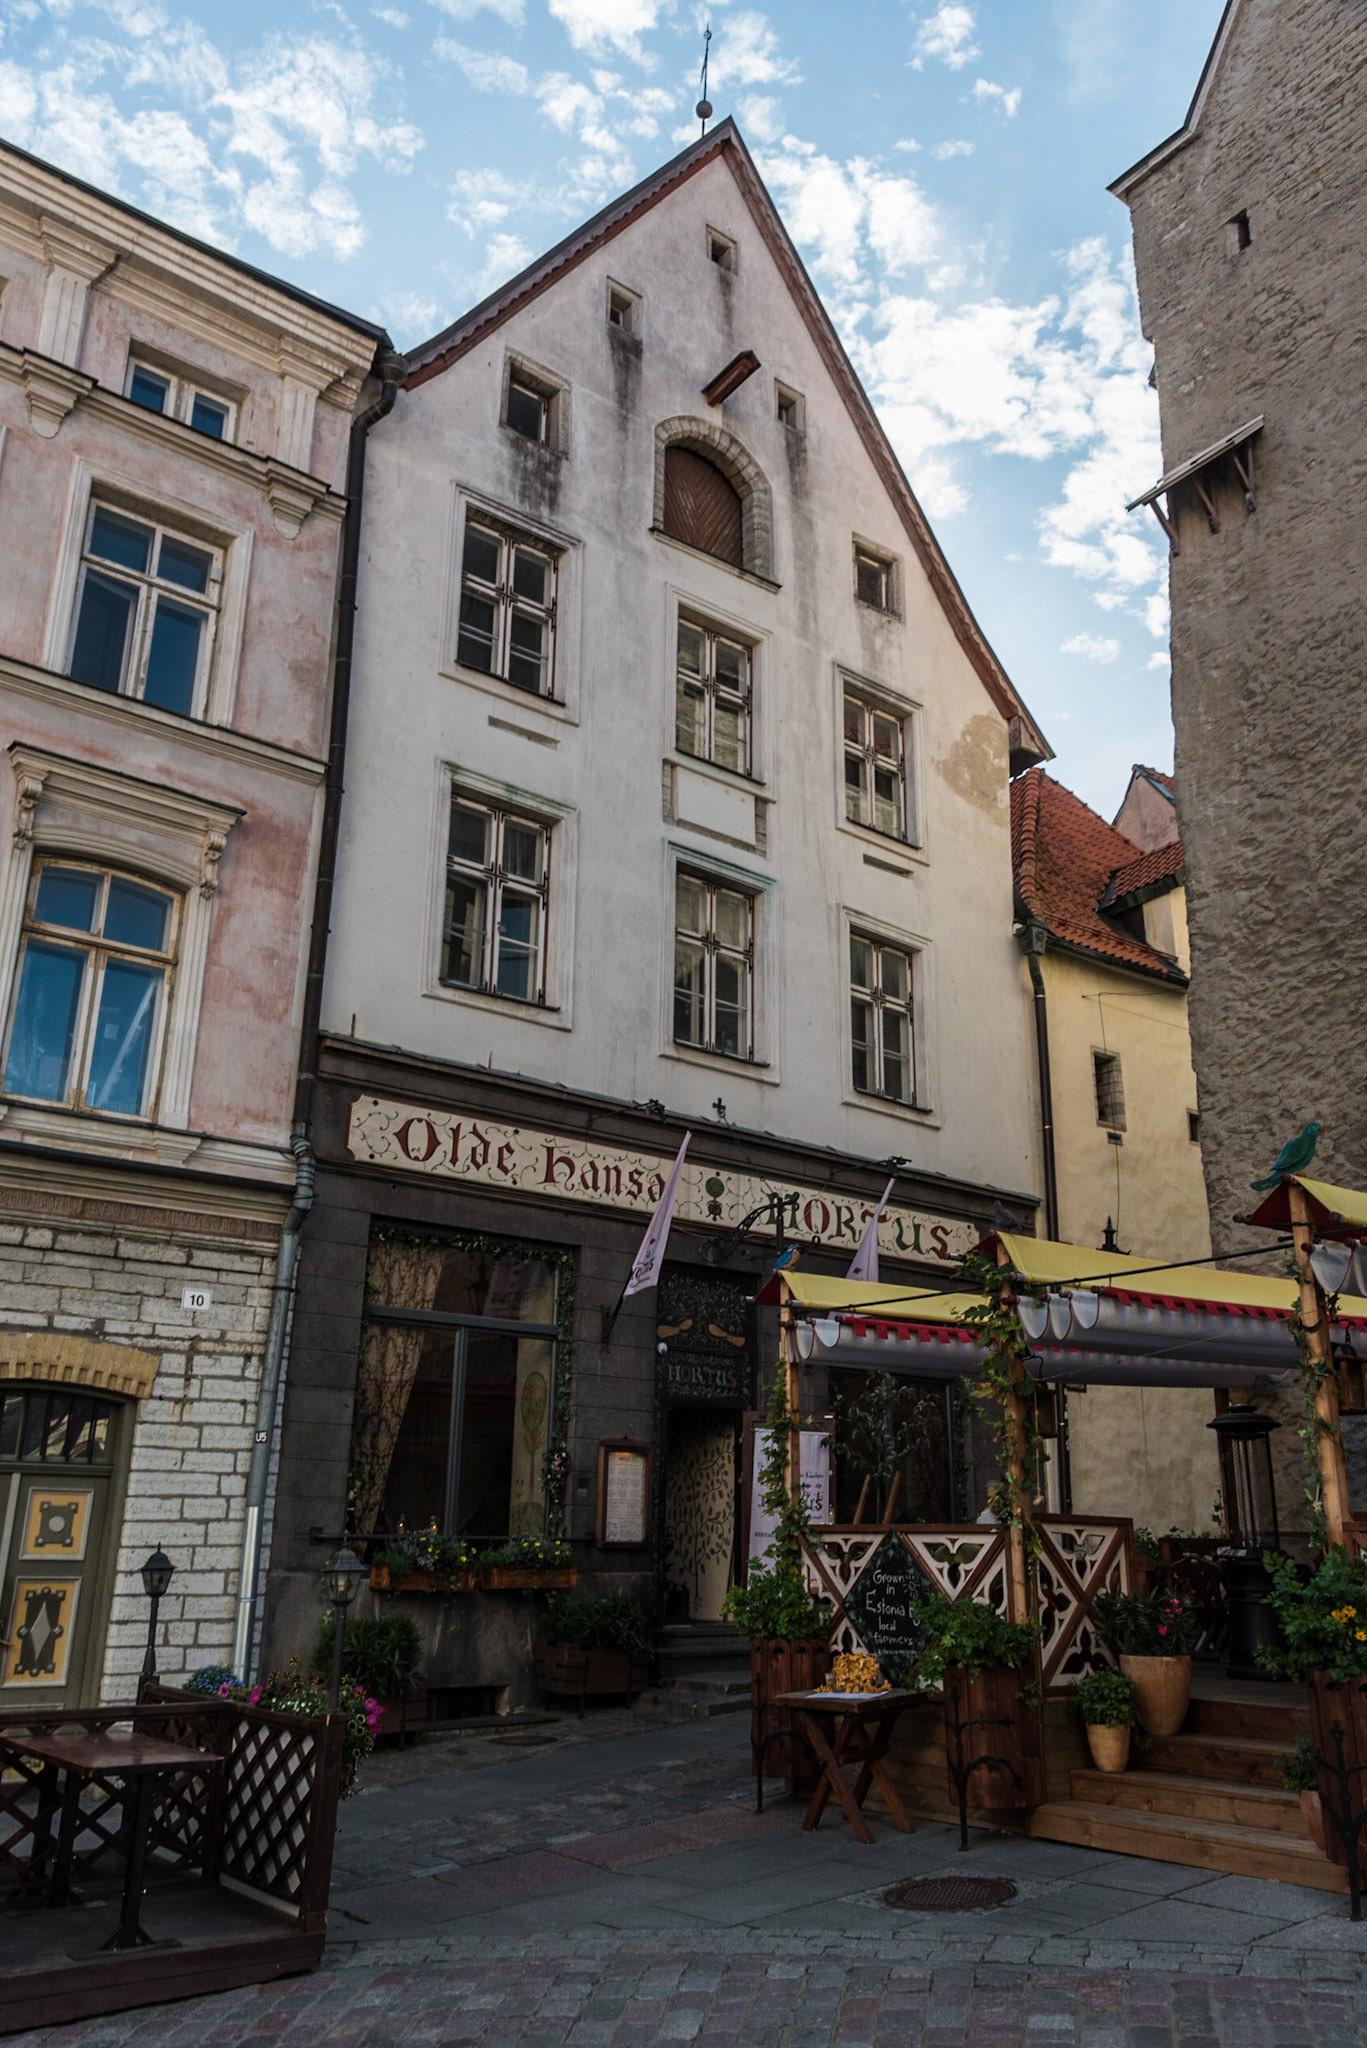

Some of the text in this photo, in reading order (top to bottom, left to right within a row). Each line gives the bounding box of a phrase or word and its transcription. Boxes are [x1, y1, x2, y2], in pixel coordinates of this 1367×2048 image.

[393, 1117, 517, 1176] Olde
[189, 1294, 205, 1307] 10
[667, 1364, 739, 1390] HORTUS
[255, 1431, 268, 1443] U5
[872, 1569, 906, 1585] Grown
[886, 1584, 896, 1596] in
[865, 1589, 906, 1617] Estonia
[878, 1616, 897, 1632] local
[873, 1631, 914, 1646] farmers
